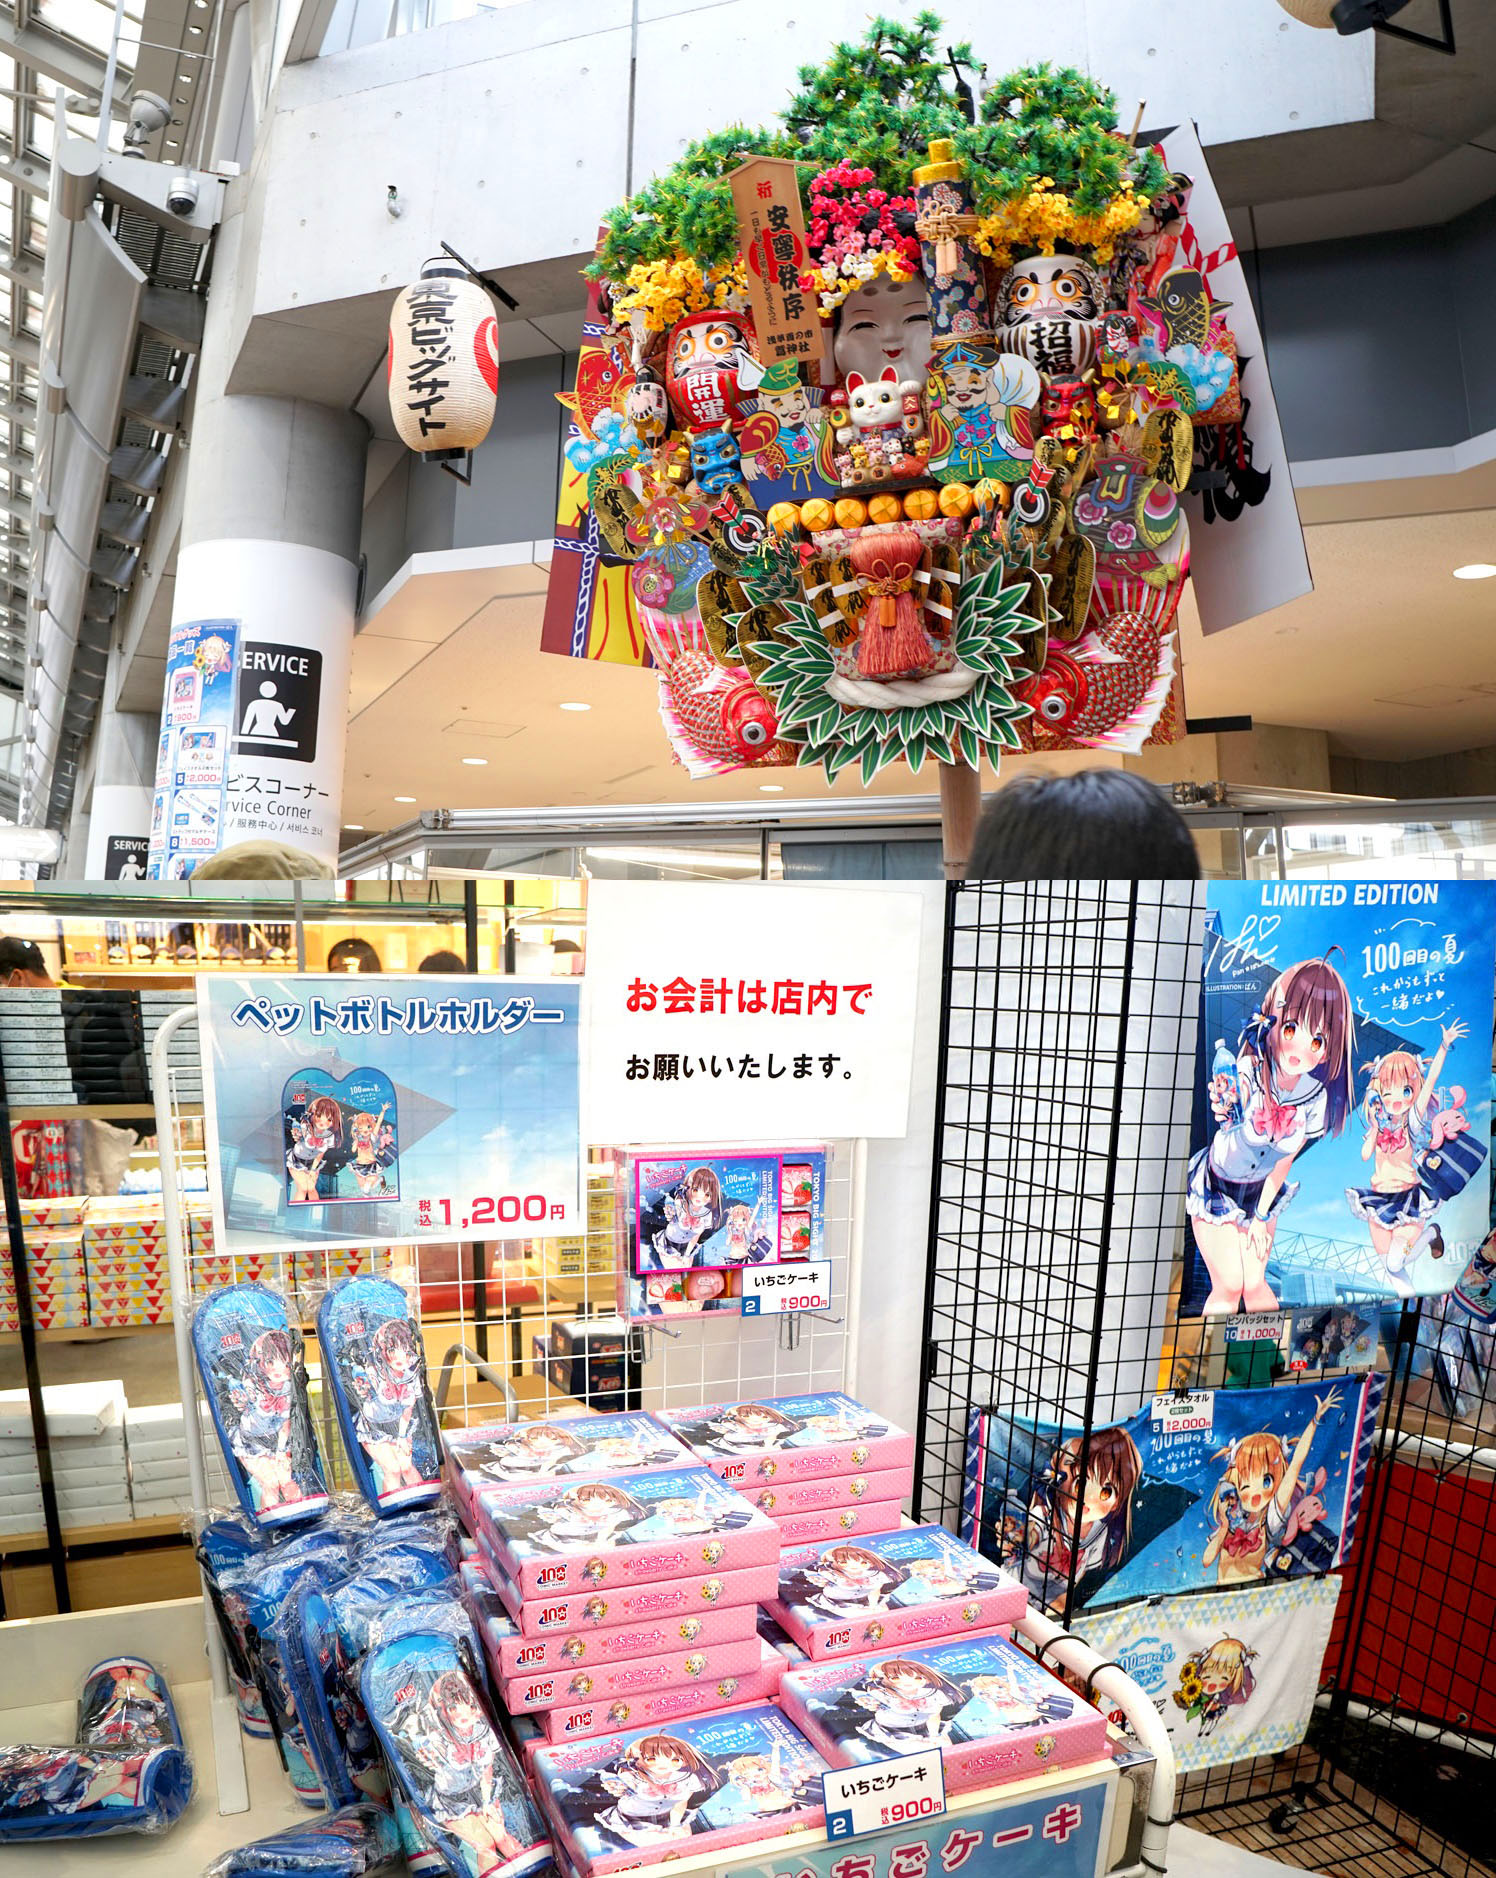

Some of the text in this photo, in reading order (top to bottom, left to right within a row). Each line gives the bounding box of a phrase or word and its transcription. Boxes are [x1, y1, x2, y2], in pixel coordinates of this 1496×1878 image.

[1029, 321, 1076, 374] 招福
[406, 281, 458, 438] 東京ビッグサイト
[686, 372, 731, 424] 開運
[241, 651, 309, 677] ERVICE
[226, 773, 329, 799] ビスコーナー
[226, 798, 312, 819] rvice Corner
[237, 818, 277, 831] 服務中心
[287, 823, 309, 834] 서비스
[114, 840, 148, 851] SERVIC
[1261, 883, 1438, 907] LIMITED EDITION
[1361, 933, 1465, 978] 100回目の夏
[626, 976, 873, 1016] お会計は店内で
[232, 995, 565, 1035] ペットボトルホルダー
[625, 1053, 851, 1081] お願いいたします。
[418, 1194, 565, 1230] 税込 1,200円
[754, 1272, 819, 1287] いちごケーキ
[745, 1300, 755, 1313] 2
[1225, 1330, 1237, 1339] 10
[1156, 1394, 1210, 1407] フェイスタオル
[1153, 1422, 1160, 1432] 5
[630, 1552, 684, 1568] いちごケーキ
[540, 1566, 566, 1582] 100
[630, 1591, 683, 1608] いちごケーキ
[542, 1606, 567, 1622] 100
[608, 1630, 661, 1647] いちごケーキ
[828, 1630, 851, 1646] 100
[520, 1646, 545, 1662] 100
[614, 1665, 667, 1683] いちごケーキ
[528, 1683, 552, 1699] 100
[650, 1690, 700, 1708] いちごケーキ
[568, 1712, 592, 1728] 100
[769, 1715, 790, 1735] TOKYO
[967, 1749, 1019, 1769] いちごケーキ
[841, 1766, 928, 1798] いちごケーキ
[892, 1797, 942, 1822] 900円
[832, 1818, 847, 1834] 2
